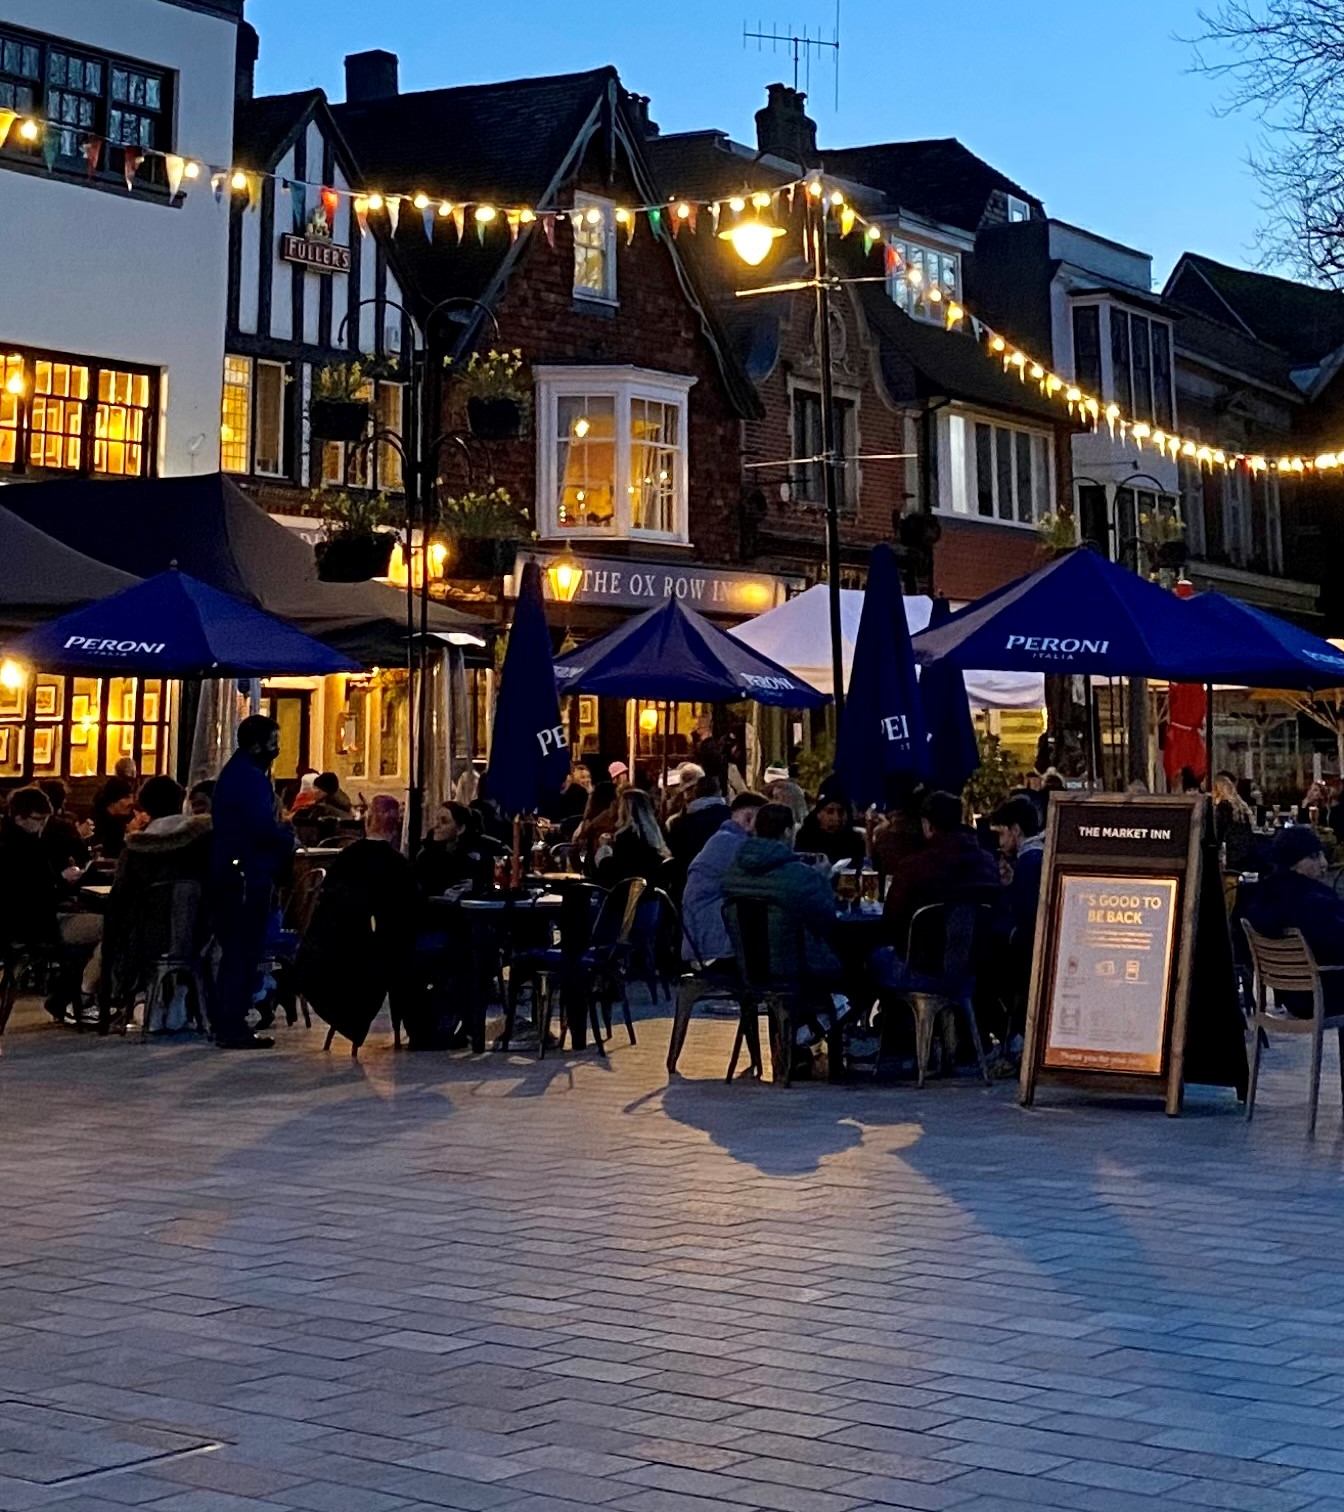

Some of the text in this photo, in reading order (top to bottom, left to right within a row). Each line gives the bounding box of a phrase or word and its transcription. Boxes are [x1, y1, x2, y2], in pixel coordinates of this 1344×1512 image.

[289, 238, 349, 267] FULLER'S
[583, 570, 621, 594] THE
[630, 574, 655, 597] OX
[664, 576, 705, 600] ROW
[64, 636, 165, 653] PERONI
[1006, 635, 1109, 654] PERONI
[1079, 826, 1171, 840] THE MARKET INN
[1099, 894, 1140, 908] GOOD
[1142, 896, 1162, 909] TO
[1106, 911, 1143, 925] BACK
